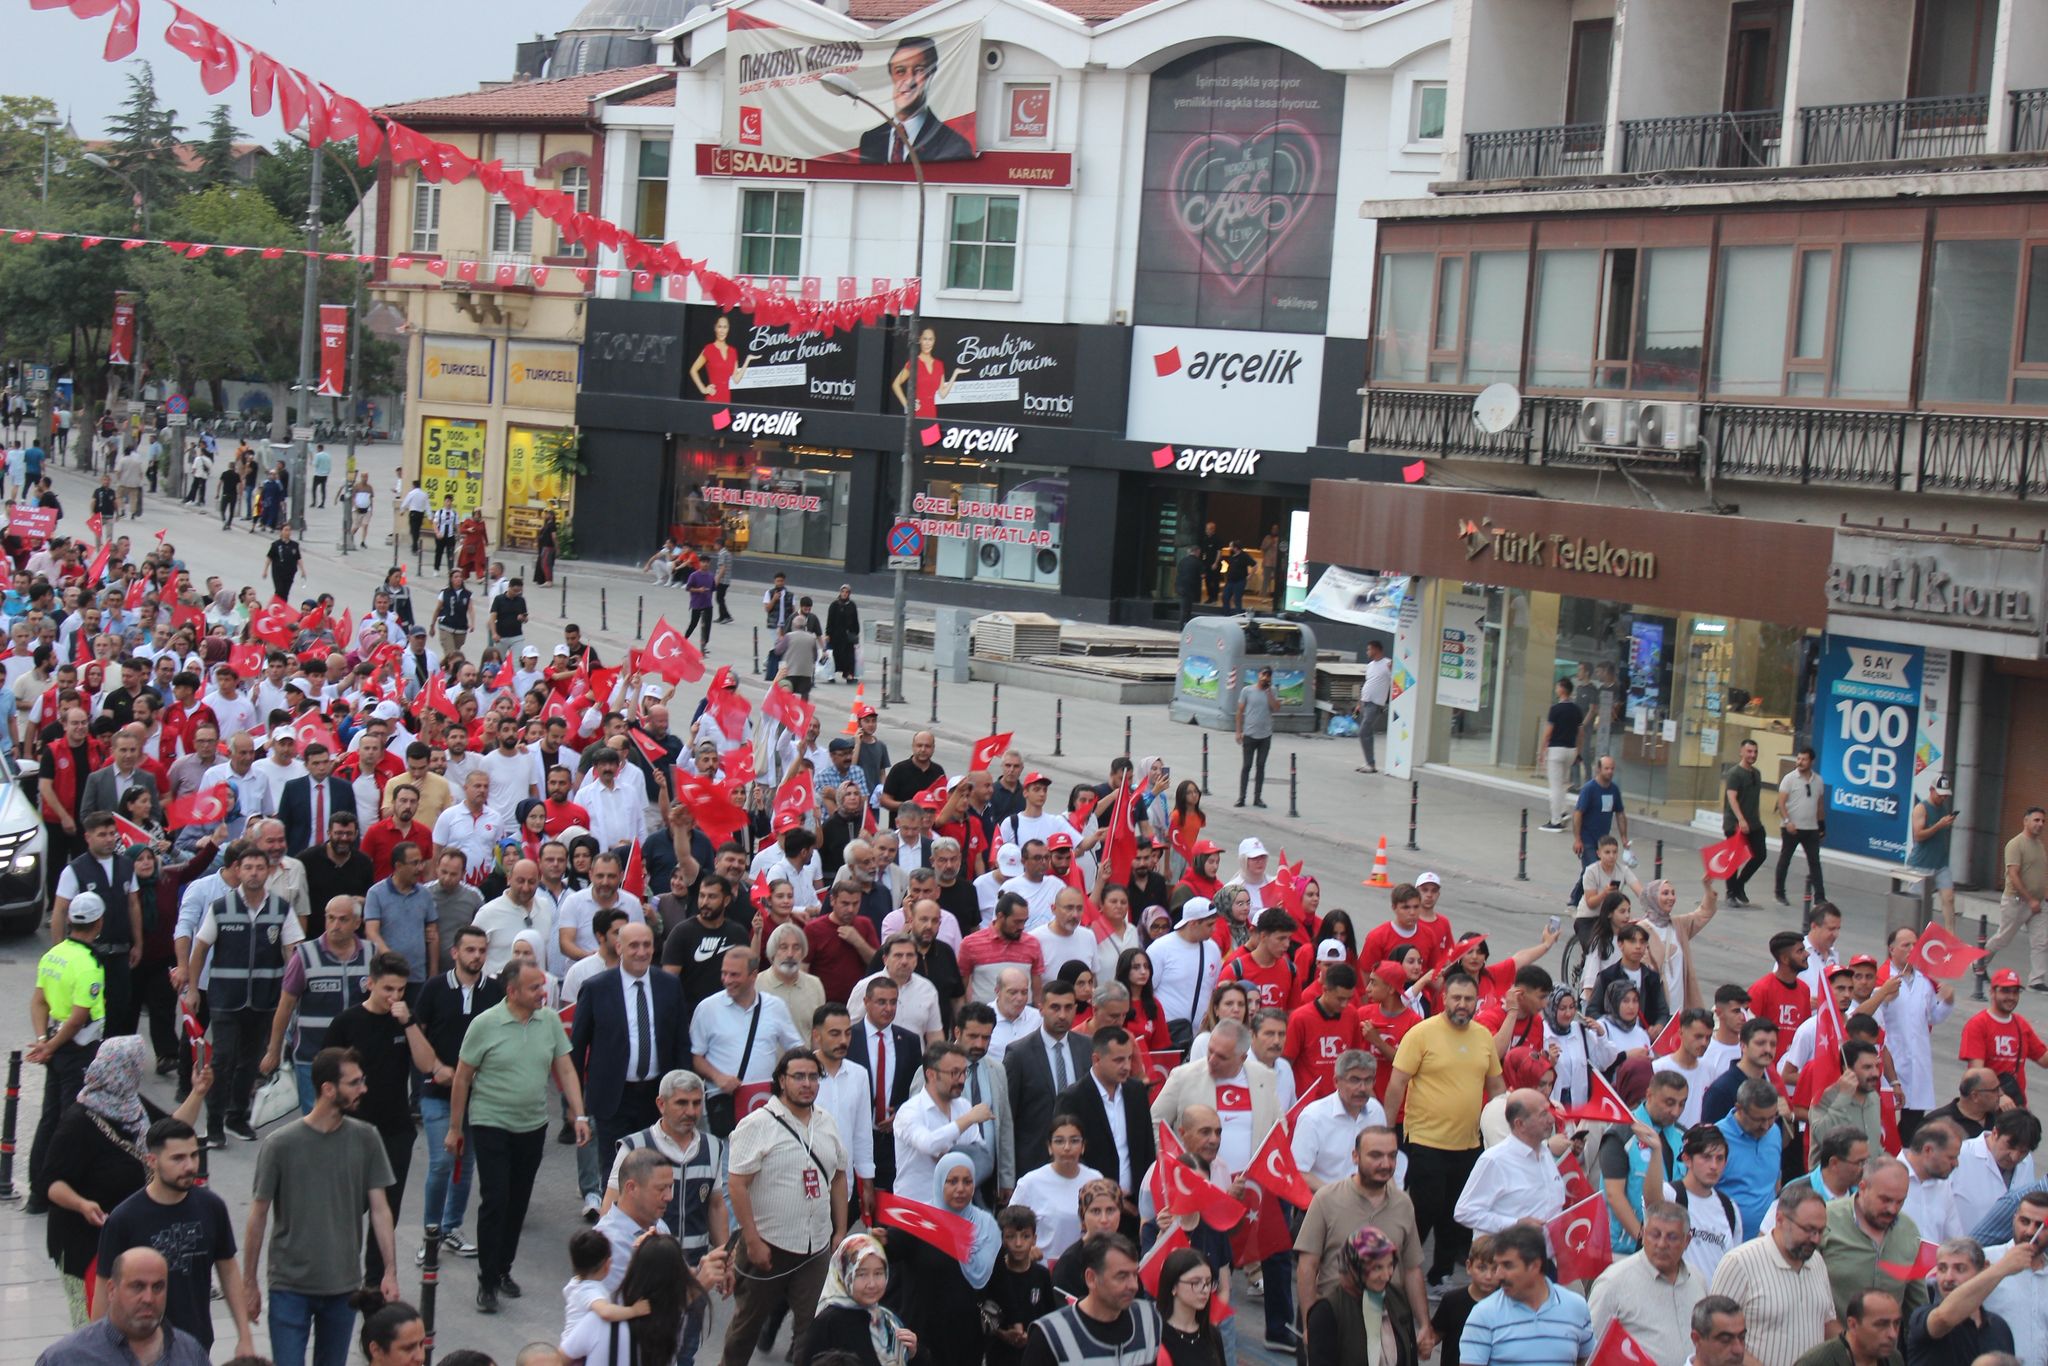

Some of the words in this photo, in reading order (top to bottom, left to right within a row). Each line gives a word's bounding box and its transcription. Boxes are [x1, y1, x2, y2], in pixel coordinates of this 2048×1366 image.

[740, 48, 802, 83] MAHMUT
[733, 155, 807, 174] SAADET
[1009, 168, 1055, 180] KARATAY
[769, 349, 795, 364] var
[957, 333, 1035, 364] Bambi'm
[440, 363, 487, 377] TURKCELL
[525, 368, 574, 383] TURKCELL
[979, 363, 1005, 378] var
[1009, 353, 1058, 375] benim.
[1187, 349, 1302, 389] arçelik
[810, 376, 856, 396] bambi
[1023, 391, 1074, 414] bambi
[732, 411, 802, 437] arçelik
[429, 428, 442, 452] 5
[943, 427, 1019, 455] arçelik
[427, 454, 441, 465] GB
[1176, 448, 1261, 477] arçelik
[445, 480, 458, 493] 60
[466, 482, 478, 494] 90
[701, 486, 823, 512] YENİLENİYORUZ
[914, 493, 956, 516] ÖZEL
[959, 500, 1035, 523] ÜRÜNLER
[973, 522, 1052, 546] FİYATLAR
[1491, 528, 1546, 566] Türk
[1549, 534, 1657, 579] Telekom
[1826, 557, 1951, 613] antik
[1952, 584, 2031, 620] HOTEL
[1863, 655, 1873, 667] 6
[1875, 657, 1893, 670] AY
[1835, 699, 1909, 748] 100
[1842, 744, 1897, 789] GB
[1833, 787, 1898, 815] ÜCRETSİZ
